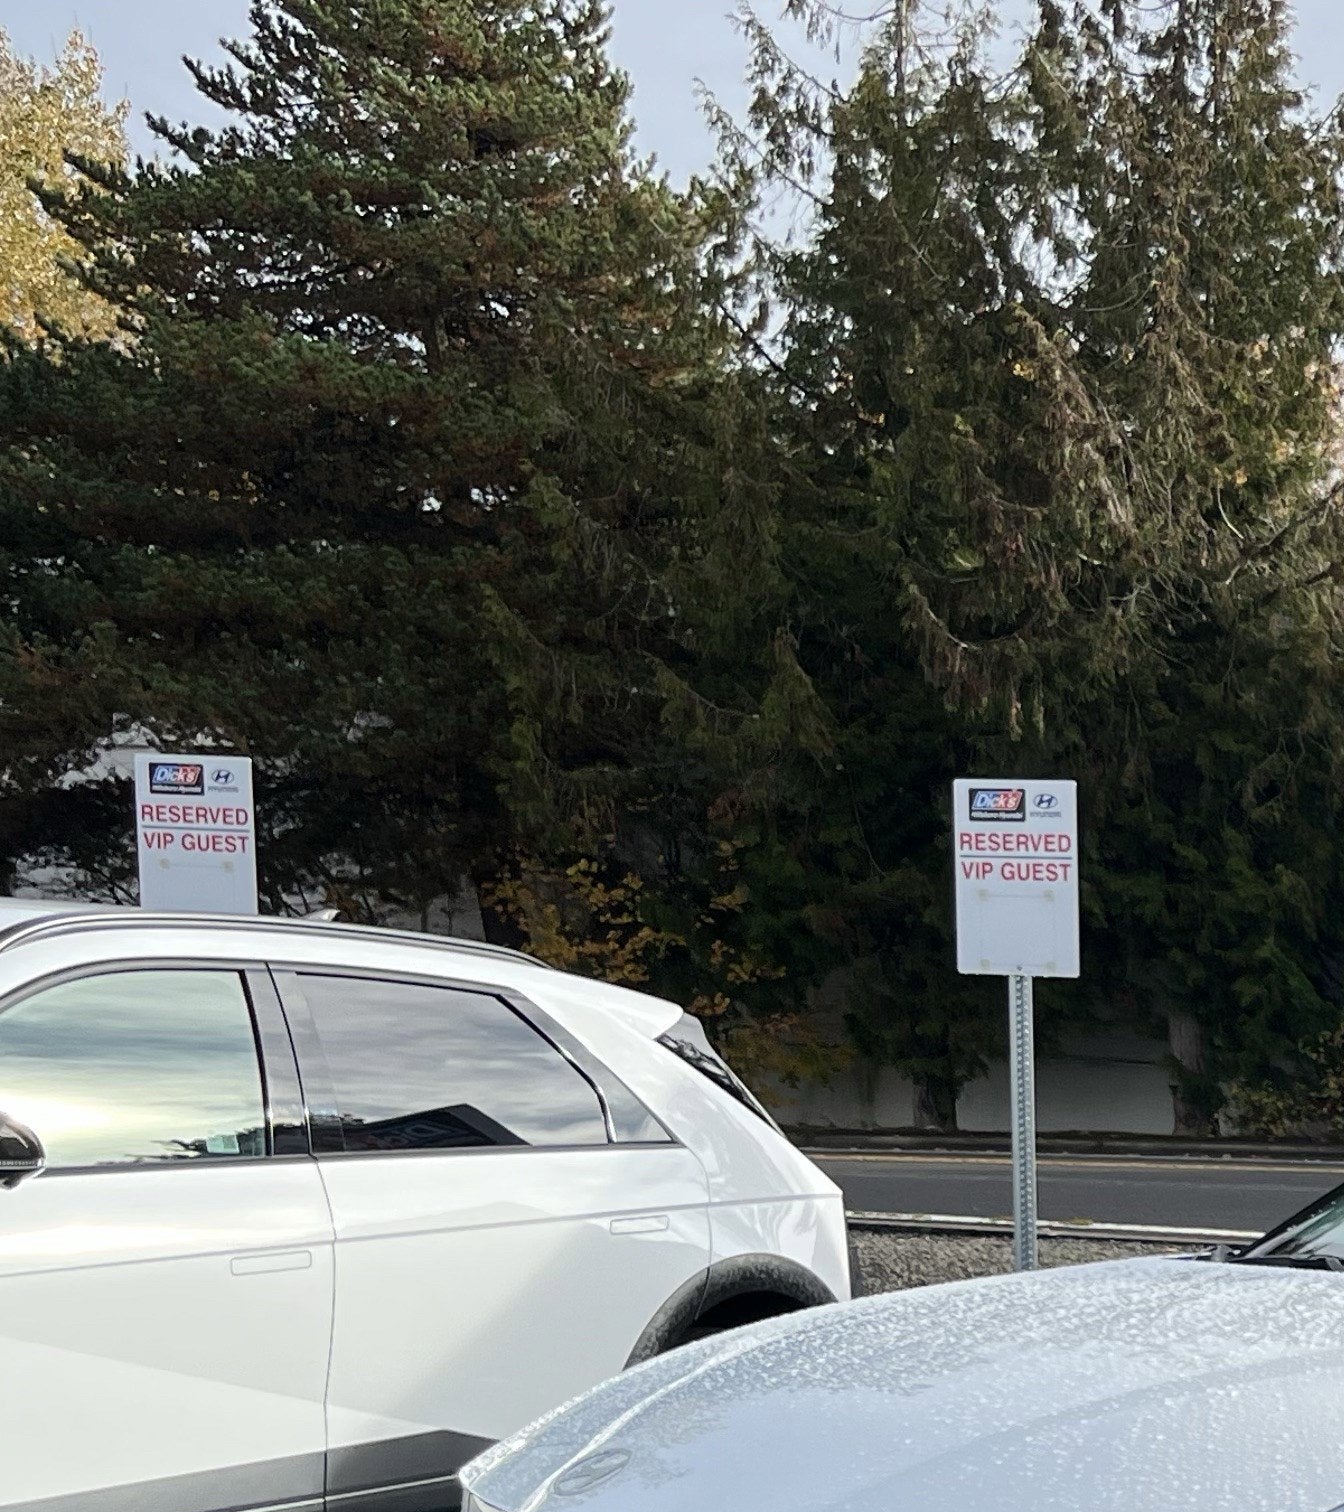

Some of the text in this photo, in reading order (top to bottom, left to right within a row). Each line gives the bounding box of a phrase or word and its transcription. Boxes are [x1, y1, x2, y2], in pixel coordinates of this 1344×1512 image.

[141, 804, 249, 826] RESERVED
[143, 832, 250, 854] VIP GUEST
[960, 832, 1071, 853] RESERVED
[961, 861, 1071, 882] VIP GUEST
